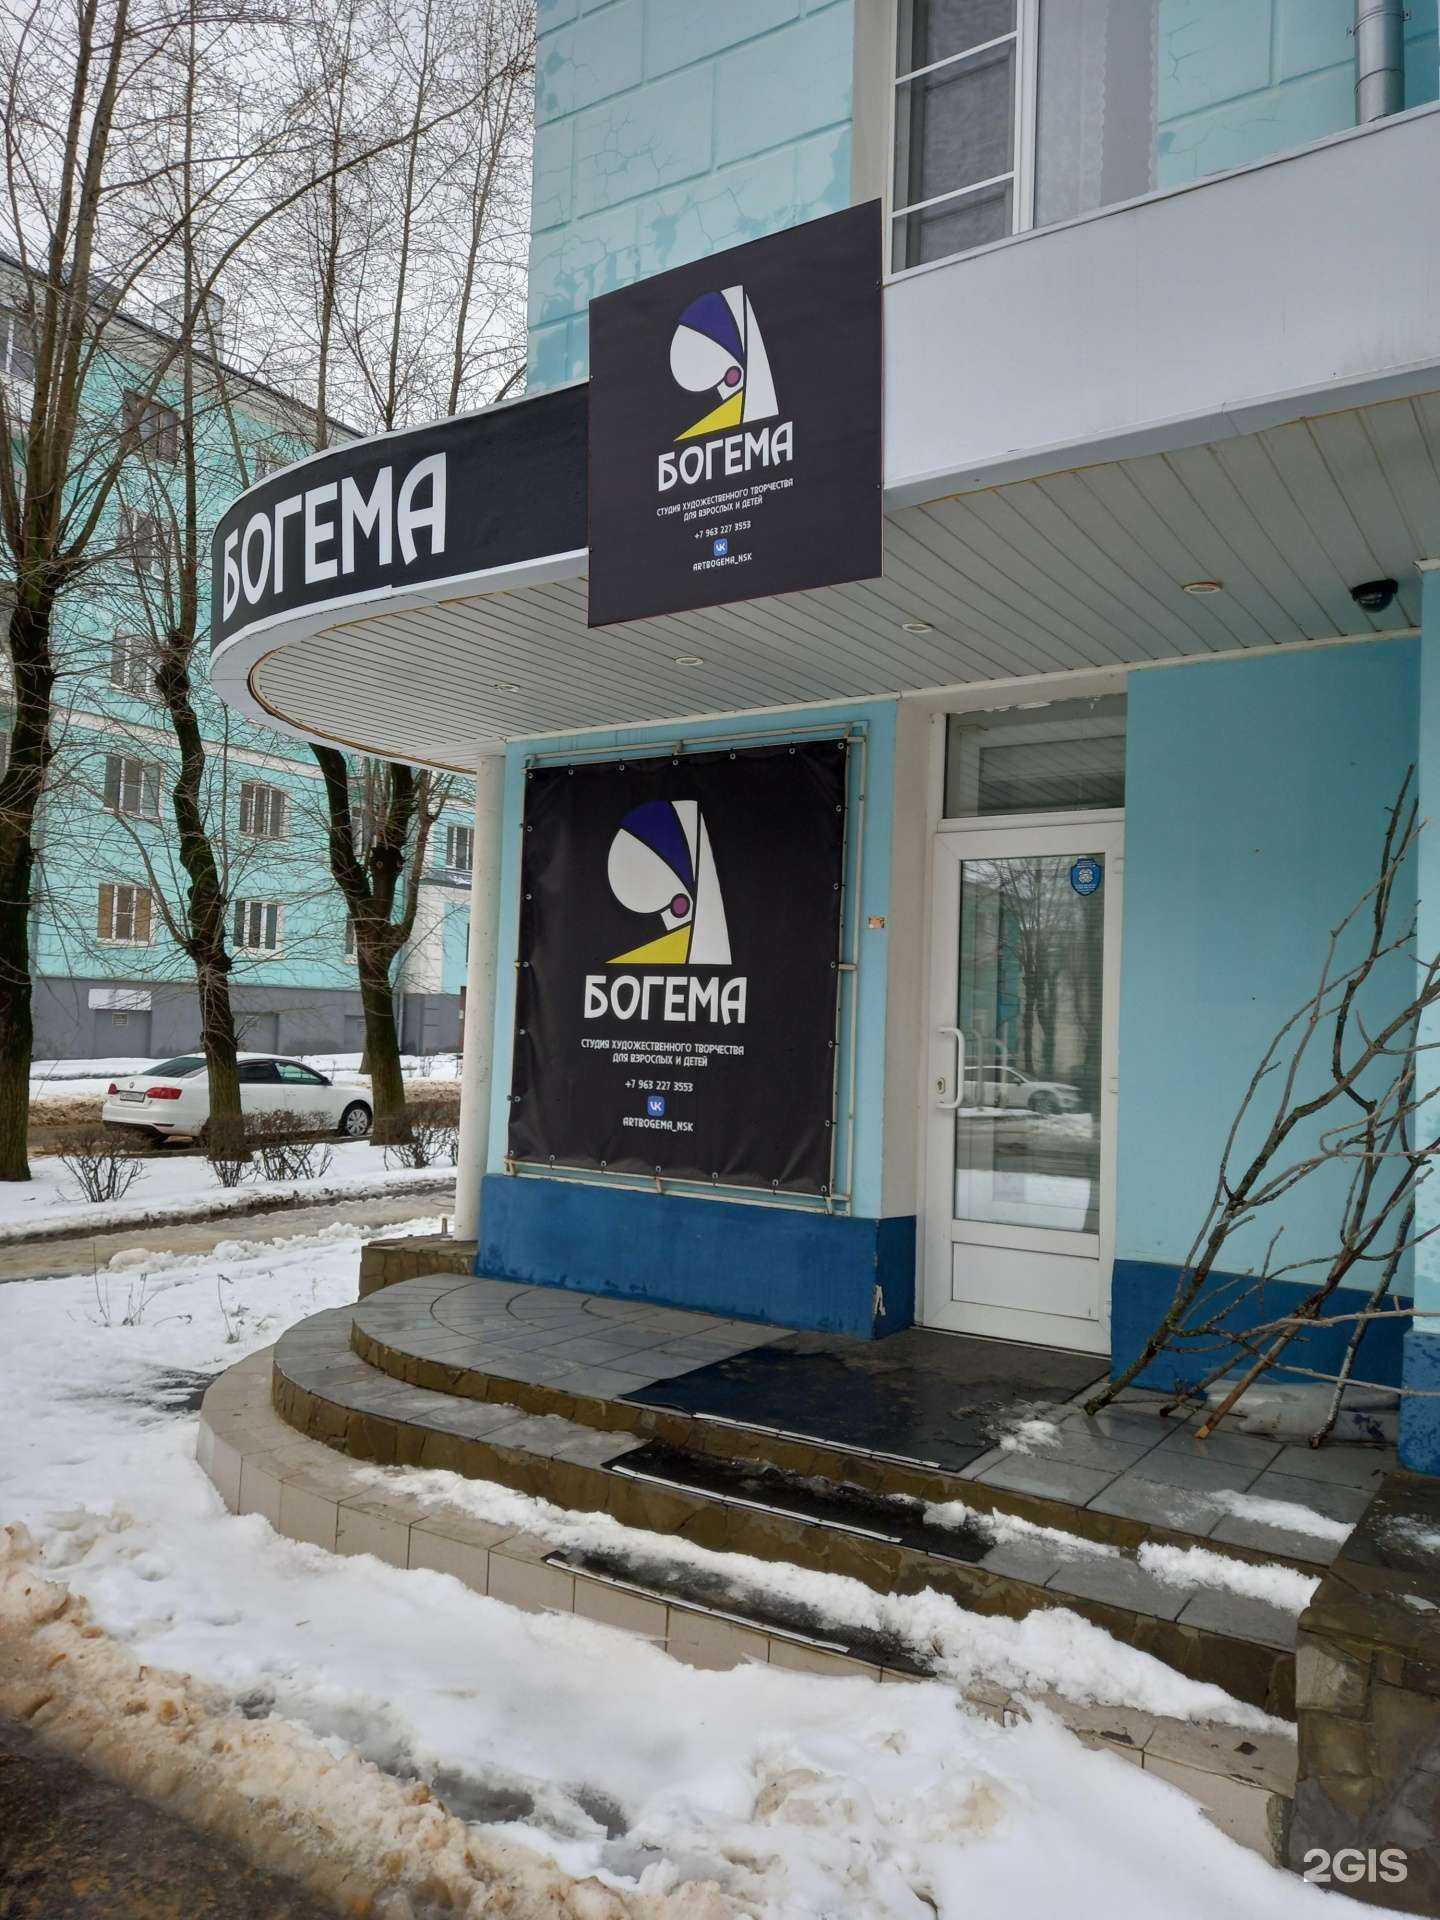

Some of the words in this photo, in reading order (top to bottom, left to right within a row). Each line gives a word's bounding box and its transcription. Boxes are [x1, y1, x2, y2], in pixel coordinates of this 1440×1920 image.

[658, 421, 793, 492] БОГЕМА
[656, 504, 681, 516] СТУДИЯ
[682, 488, 748, 511] ХУДОЖЕСТВЕННОГО
[751, 478, 793, 495] ТВОРЧЕСТВА
[684, 509, 697, 522] ДЛЯ
[698, 504, 733, 518] ВЗРОСЛЫХ
[742, 495, 763, 508] ДЕТЕЙ
[223, 452, 447, 623] БОГЕМА
[694, 530, 703, 539] +7
[706, 528, 718, 537] 963
[720, 524, 732, 534] 227
[735, 521, 751, 531] 3553
[693, 553, 752, 571] ARTBOGEMA_NSK
[584, 975, 747, 1025] БОГЕМА
[581, 1039, 610, 1049] СТУДИЯ
[612, 1040, 692, 1052] ХУДОЖЕСТВЕННОГО
[695, 1044, 744, 1055] ТВОРЧЕСТВА
[613, 1053, 628, 1063] ДЛЯ
[631, 1054, 673, 1064] ВЗРОСЛЫХ
[676, 1056, 681, 1064] И
[683, 1055, 708, 1067] ДЕТЕЙ
[625, 1080, 635, 1089] +7
[638, 1080, 653, 1089] 963
[656, 1081, 670, 1090] 227
[674, 1082, 693, 1092] 3553
[623, 1117, 693, 1132] ARTBOGEMA_NSK
